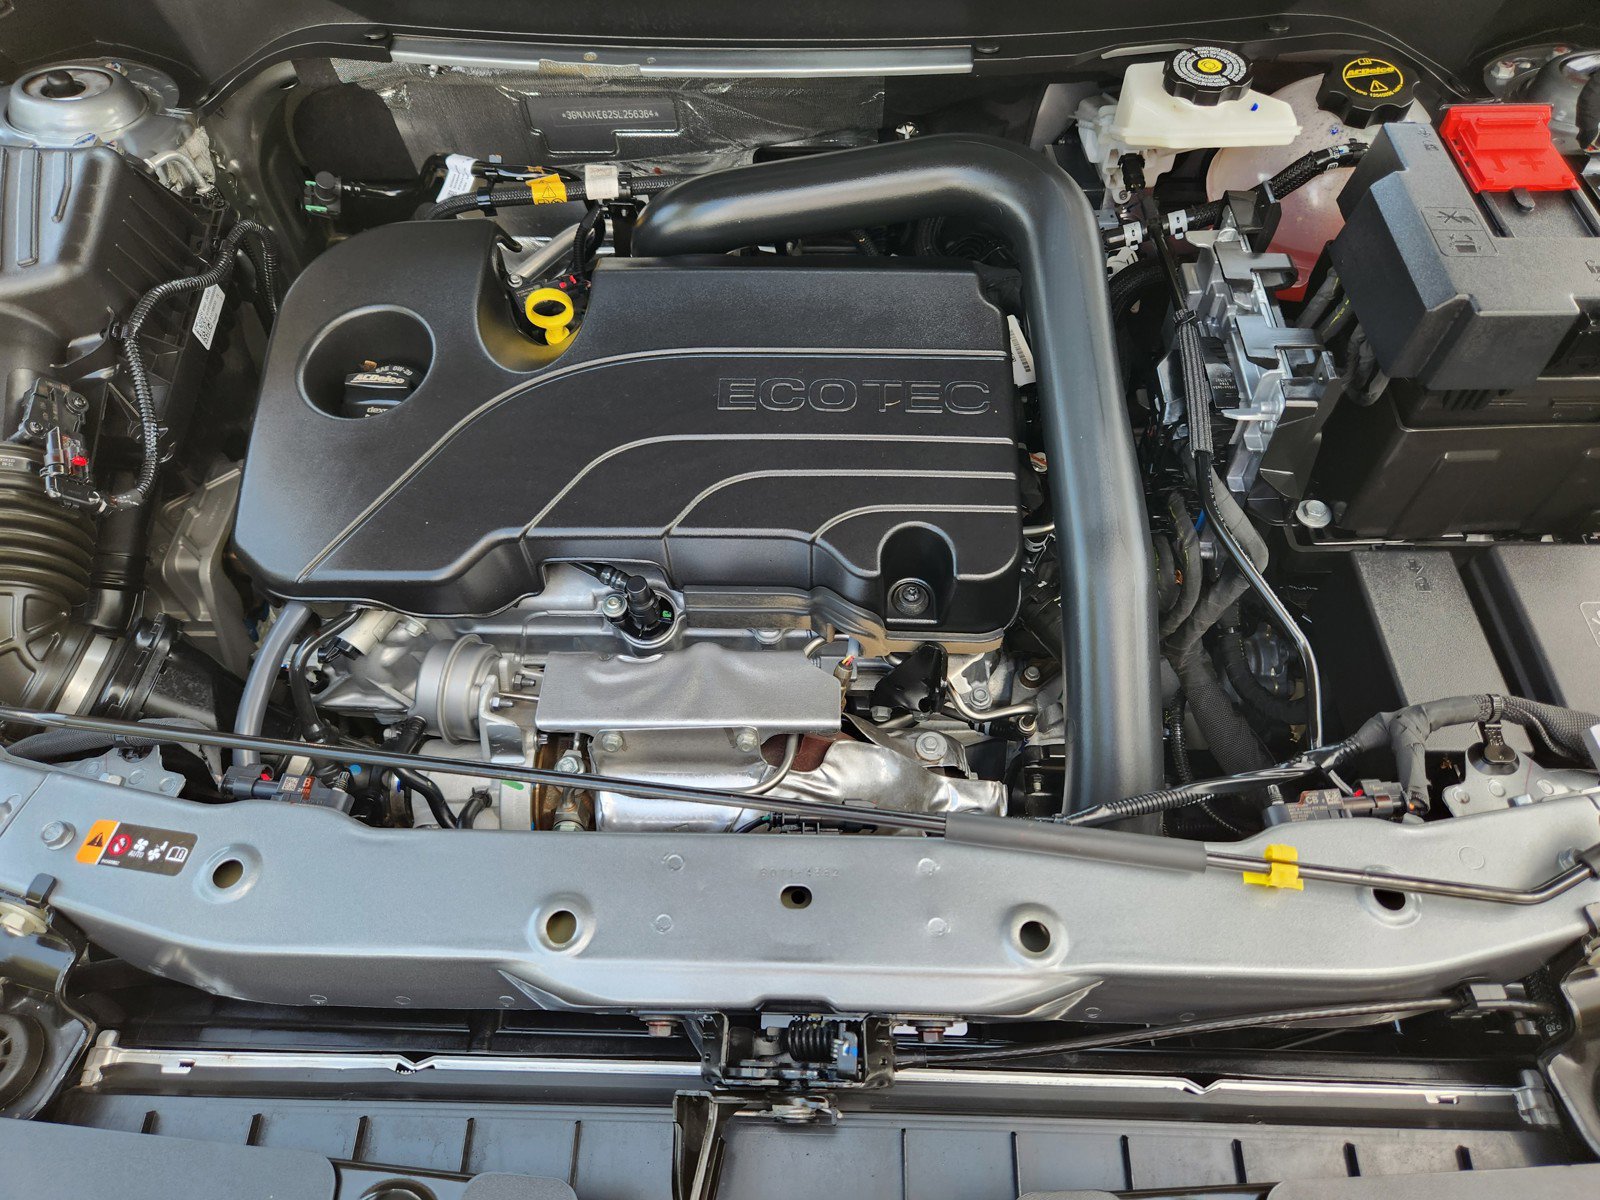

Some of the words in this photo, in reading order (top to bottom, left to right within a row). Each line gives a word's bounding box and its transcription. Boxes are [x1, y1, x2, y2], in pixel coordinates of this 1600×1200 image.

[375, 365, 390, 374] SAE
[392, 365, 413, 376] 0W-20
[352, 373, 405, 384] ACDelco
[717, 377, 991, 415] ECOTEC
[127, 850, 145, 858] AUTO
